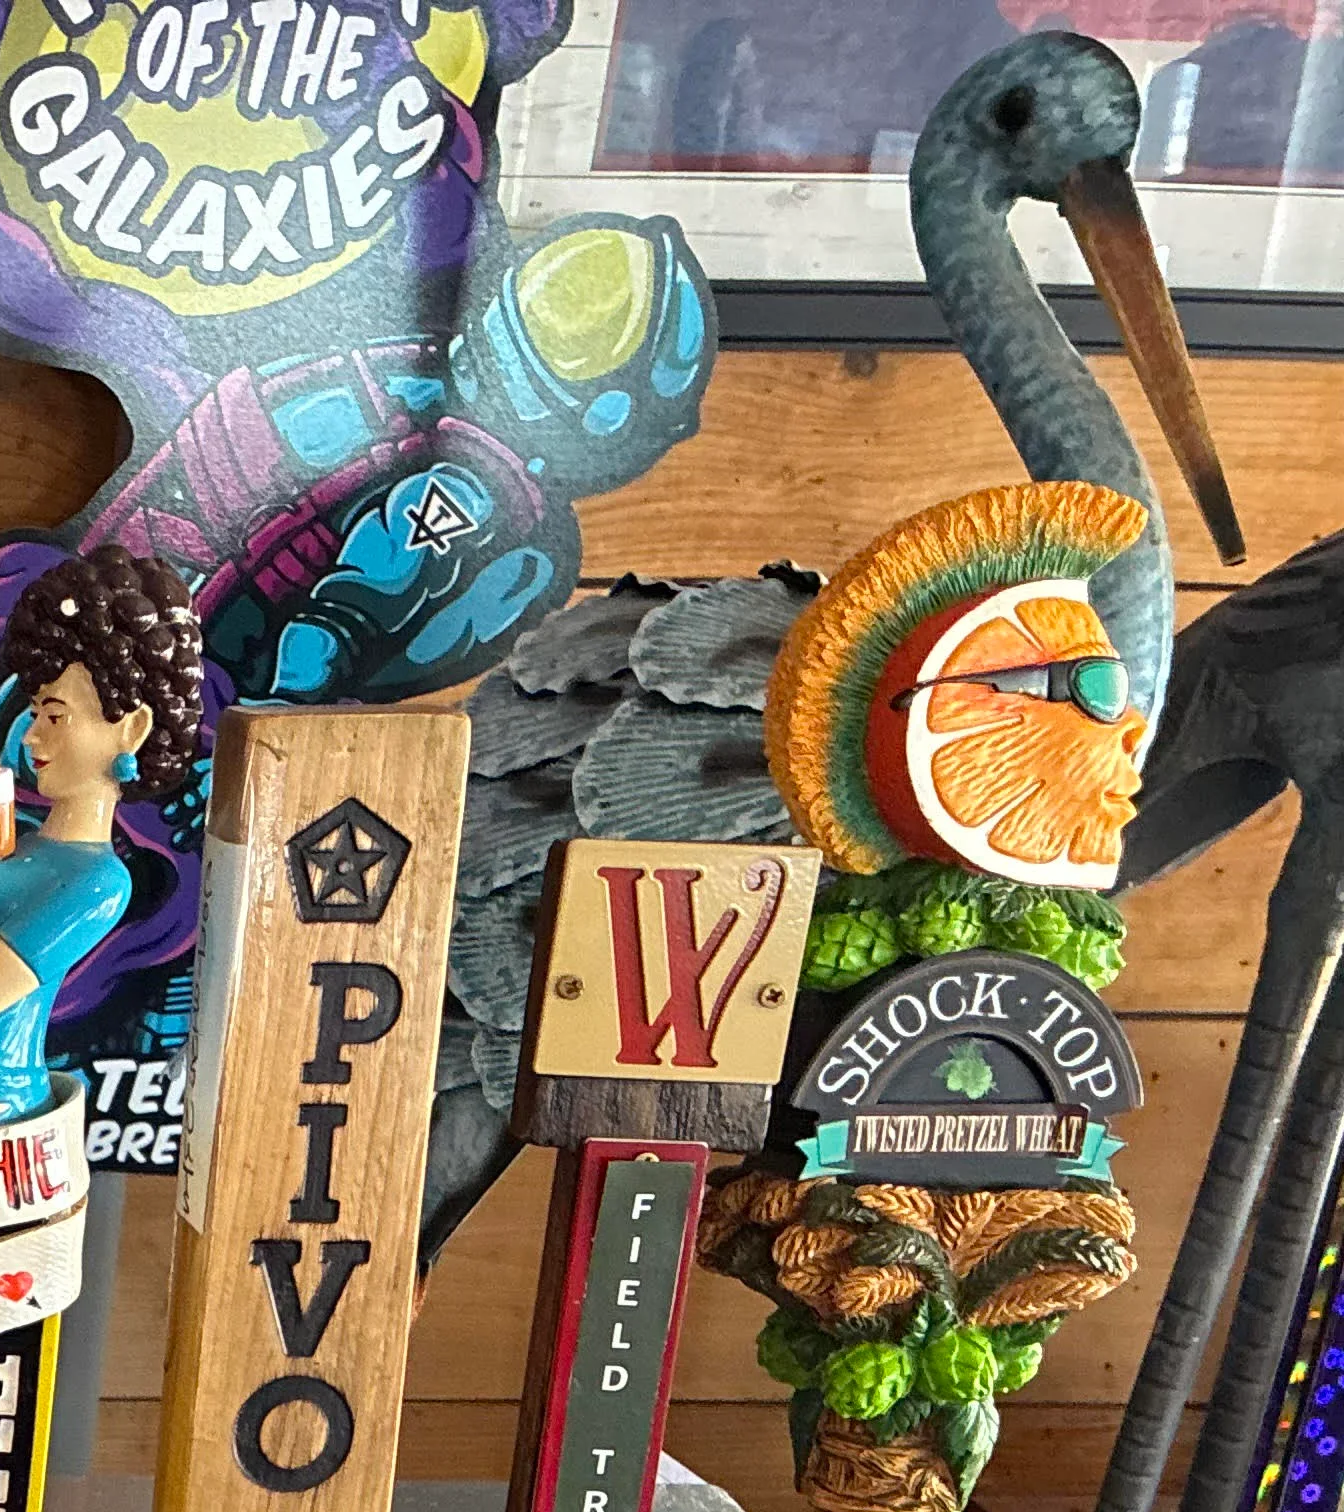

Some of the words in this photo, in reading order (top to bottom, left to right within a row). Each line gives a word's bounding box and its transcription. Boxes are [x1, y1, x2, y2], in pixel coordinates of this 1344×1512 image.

[137, 2, 227, 101] OF
[245, 1, 376, 110] THE
[9, 65, 445, 272] GALAXIES
[596, 858, 786, 1069] W
[817, 972, 1016, 1106] SHOCK
[1028, 990, 1117, 1099] TOP
[231, 961, 405, 1494] PIVO
[854, 1116, 931, 1154] TWISTED
[932, 1115, 1010, 1154] PRETZEL
[601, 1193, 655, 1394] FIELD
